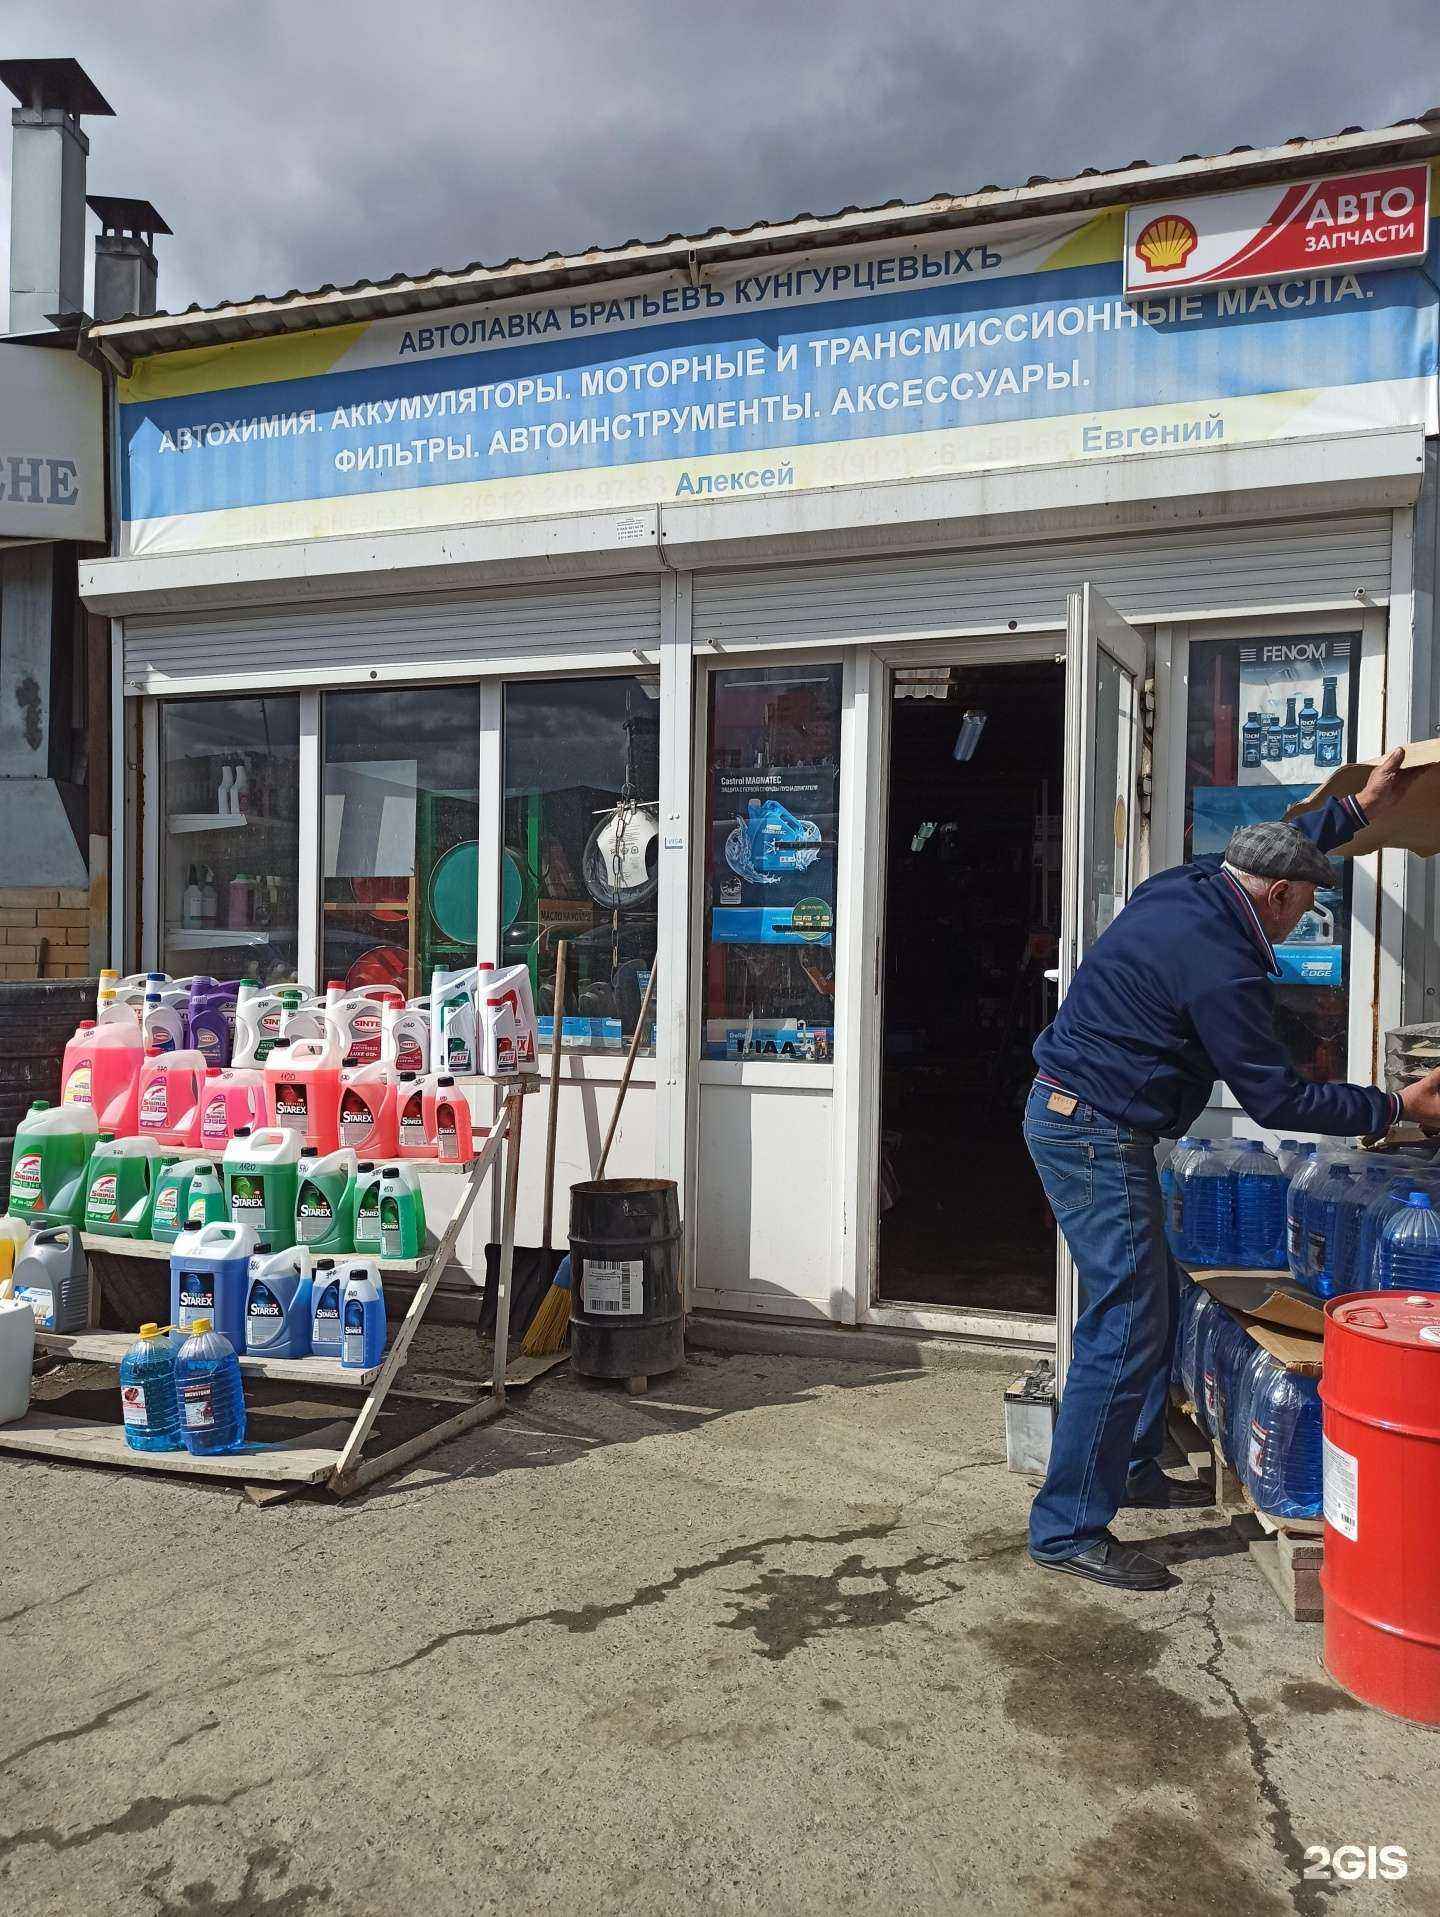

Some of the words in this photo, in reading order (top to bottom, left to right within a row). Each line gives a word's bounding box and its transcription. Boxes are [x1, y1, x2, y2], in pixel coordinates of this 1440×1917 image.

[1306, 186, 1415, 230] АВТО
[1305, 222, 1414, 253] ЗАПЧАСТИ
[399, 309, 561, 354] АВТОЛАВКА
[569, 282, 724, 329] БРАТЬЕВЪ
[735, 246, 1002, 304] КУНГУРЦЕВЫХЪ
[158, 409, 323, 454] АВТОХИМИЯ.
[330, 375, 572, 430] АККУМУЛЯТОРЫ.
[581, 346, 766, 398] МОТОРНЫЕ
[777, 343, 797, 373] И
[809, 295, 1204, 367] ТРАНСМИССИОННЫЕ
[1217, 273, 1374, 318] МАСЛА.
[334, 432, 480, 473] ФИЛЬТРЫ.
[488, 393, 820, 456] АВТОИНСТРУМЕНТЫ.
[830, 360, 1090, 416] АКСЕССУАРЫ.
[1082, 412, 1225, 453] Евгений
[0, 456, 79, 505] HE
[675, 460, 794, 497] Алексей
[1263, 642, 1326, 662] FENOM
[721, 777, 745, 785] Castrol
[745, 776, 782, 785] MAGNATEC
[354, 1020, 381, 1028] SINTE
[277, 1101, 307, 1114] STAREX
[343, 1111, 373, 1123] STAREX
[232, 1195, 262, 1207] STAREX
[301, 1205, 331, 1217] STAREX
[180, 1292, 212, 1306] STAREX
[250, 1303, 279, 1316] STAREX
